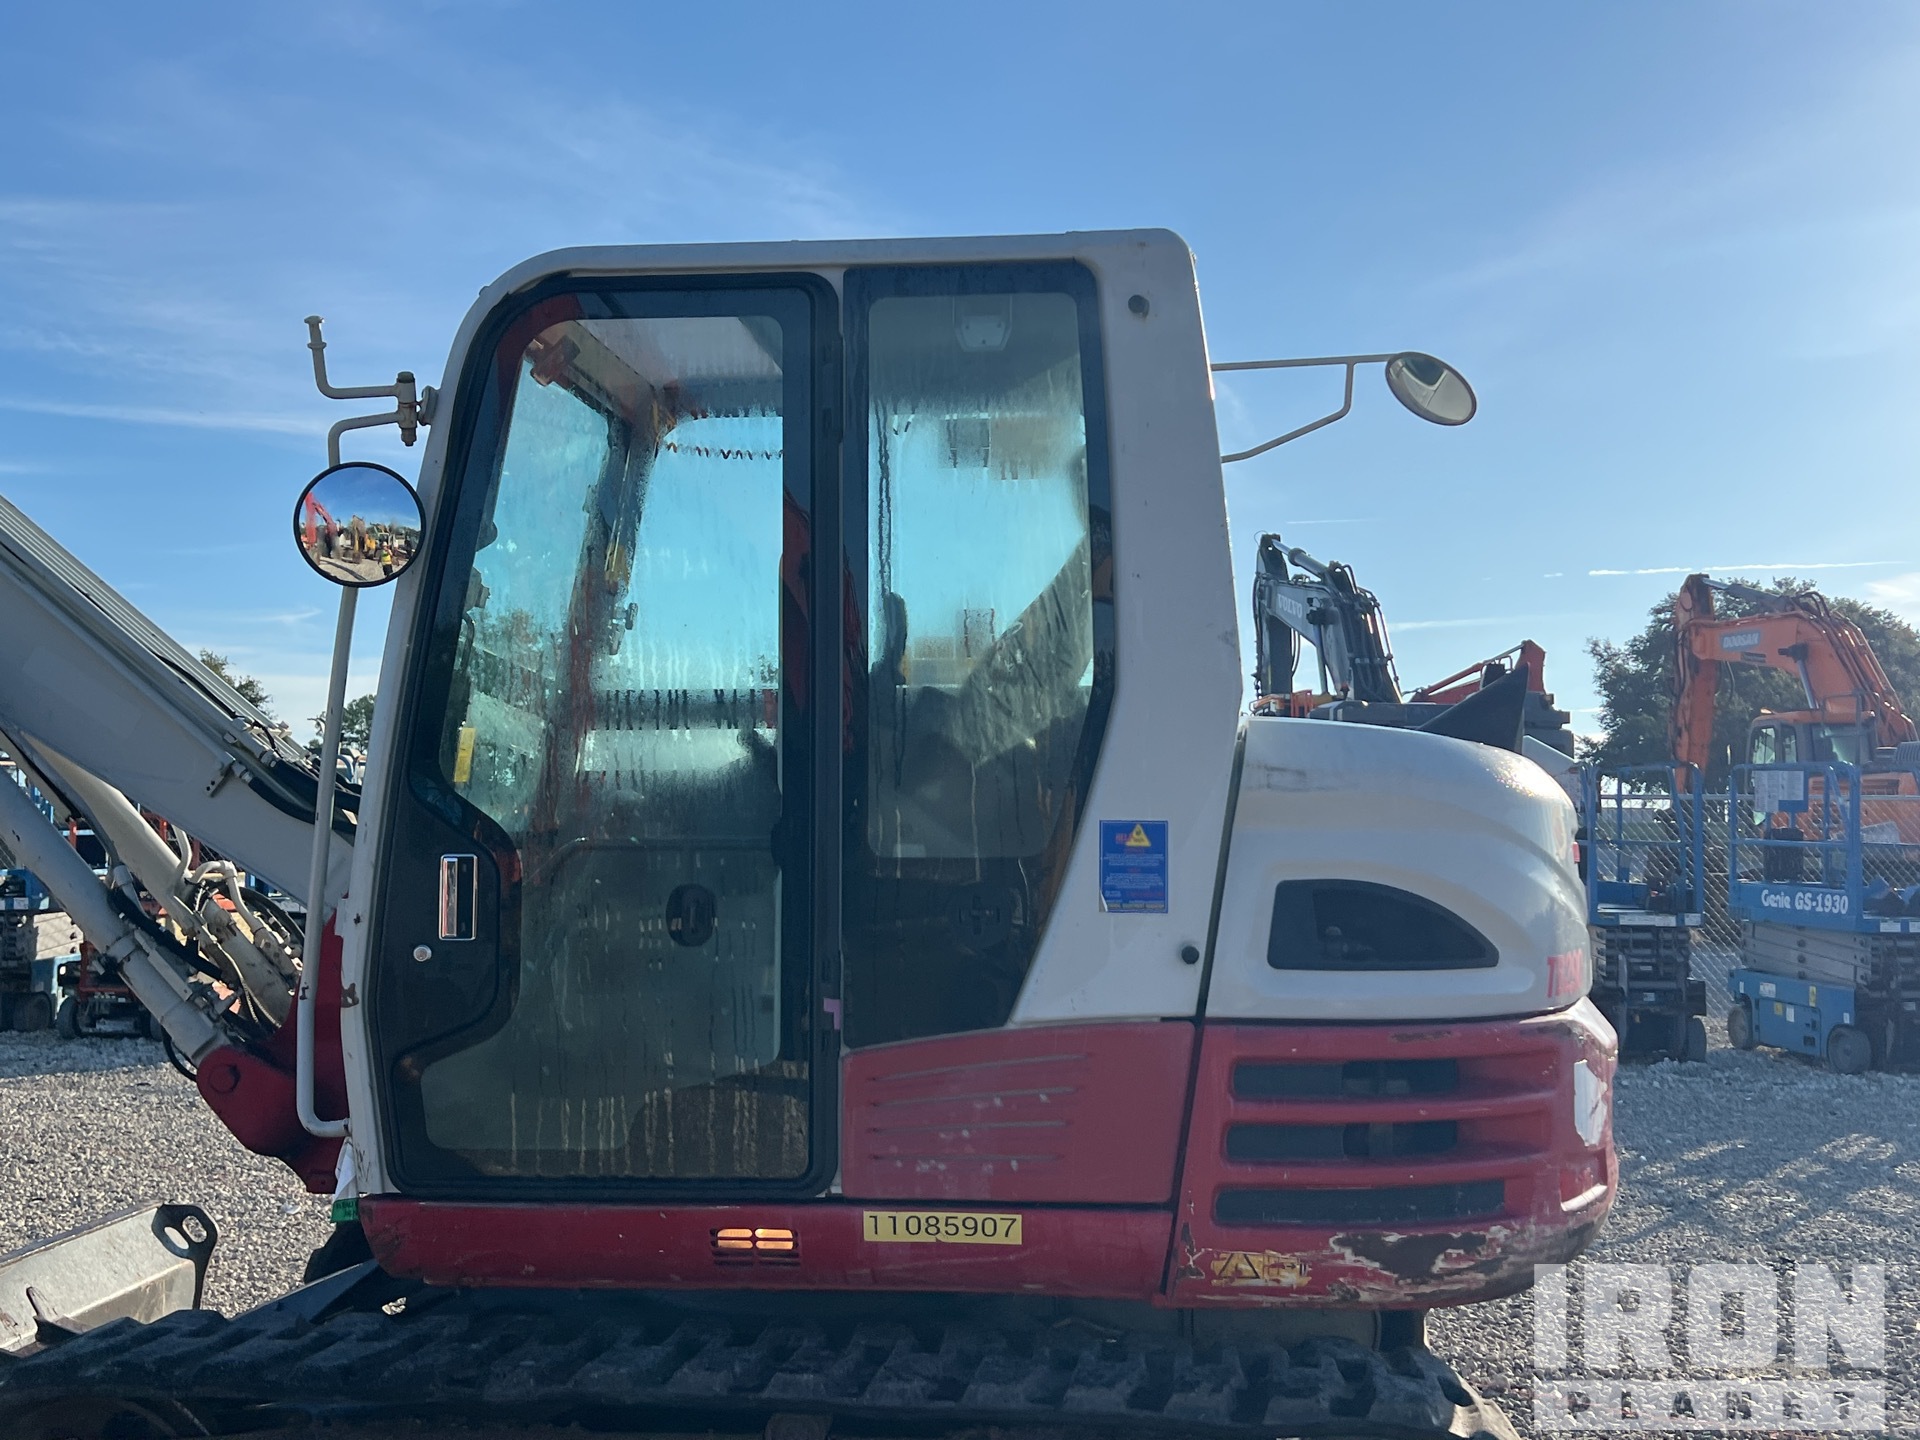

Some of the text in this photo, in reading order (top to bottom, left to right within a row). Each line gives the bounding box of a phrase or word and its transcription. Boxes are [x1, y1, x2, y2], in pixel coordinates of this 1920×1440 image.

[1277, 594, 1303, 618] VOLVO
[1761, 889, 1849, 914] Genie GS-1930
[869, 1215, 1017, 1238] 11085907
